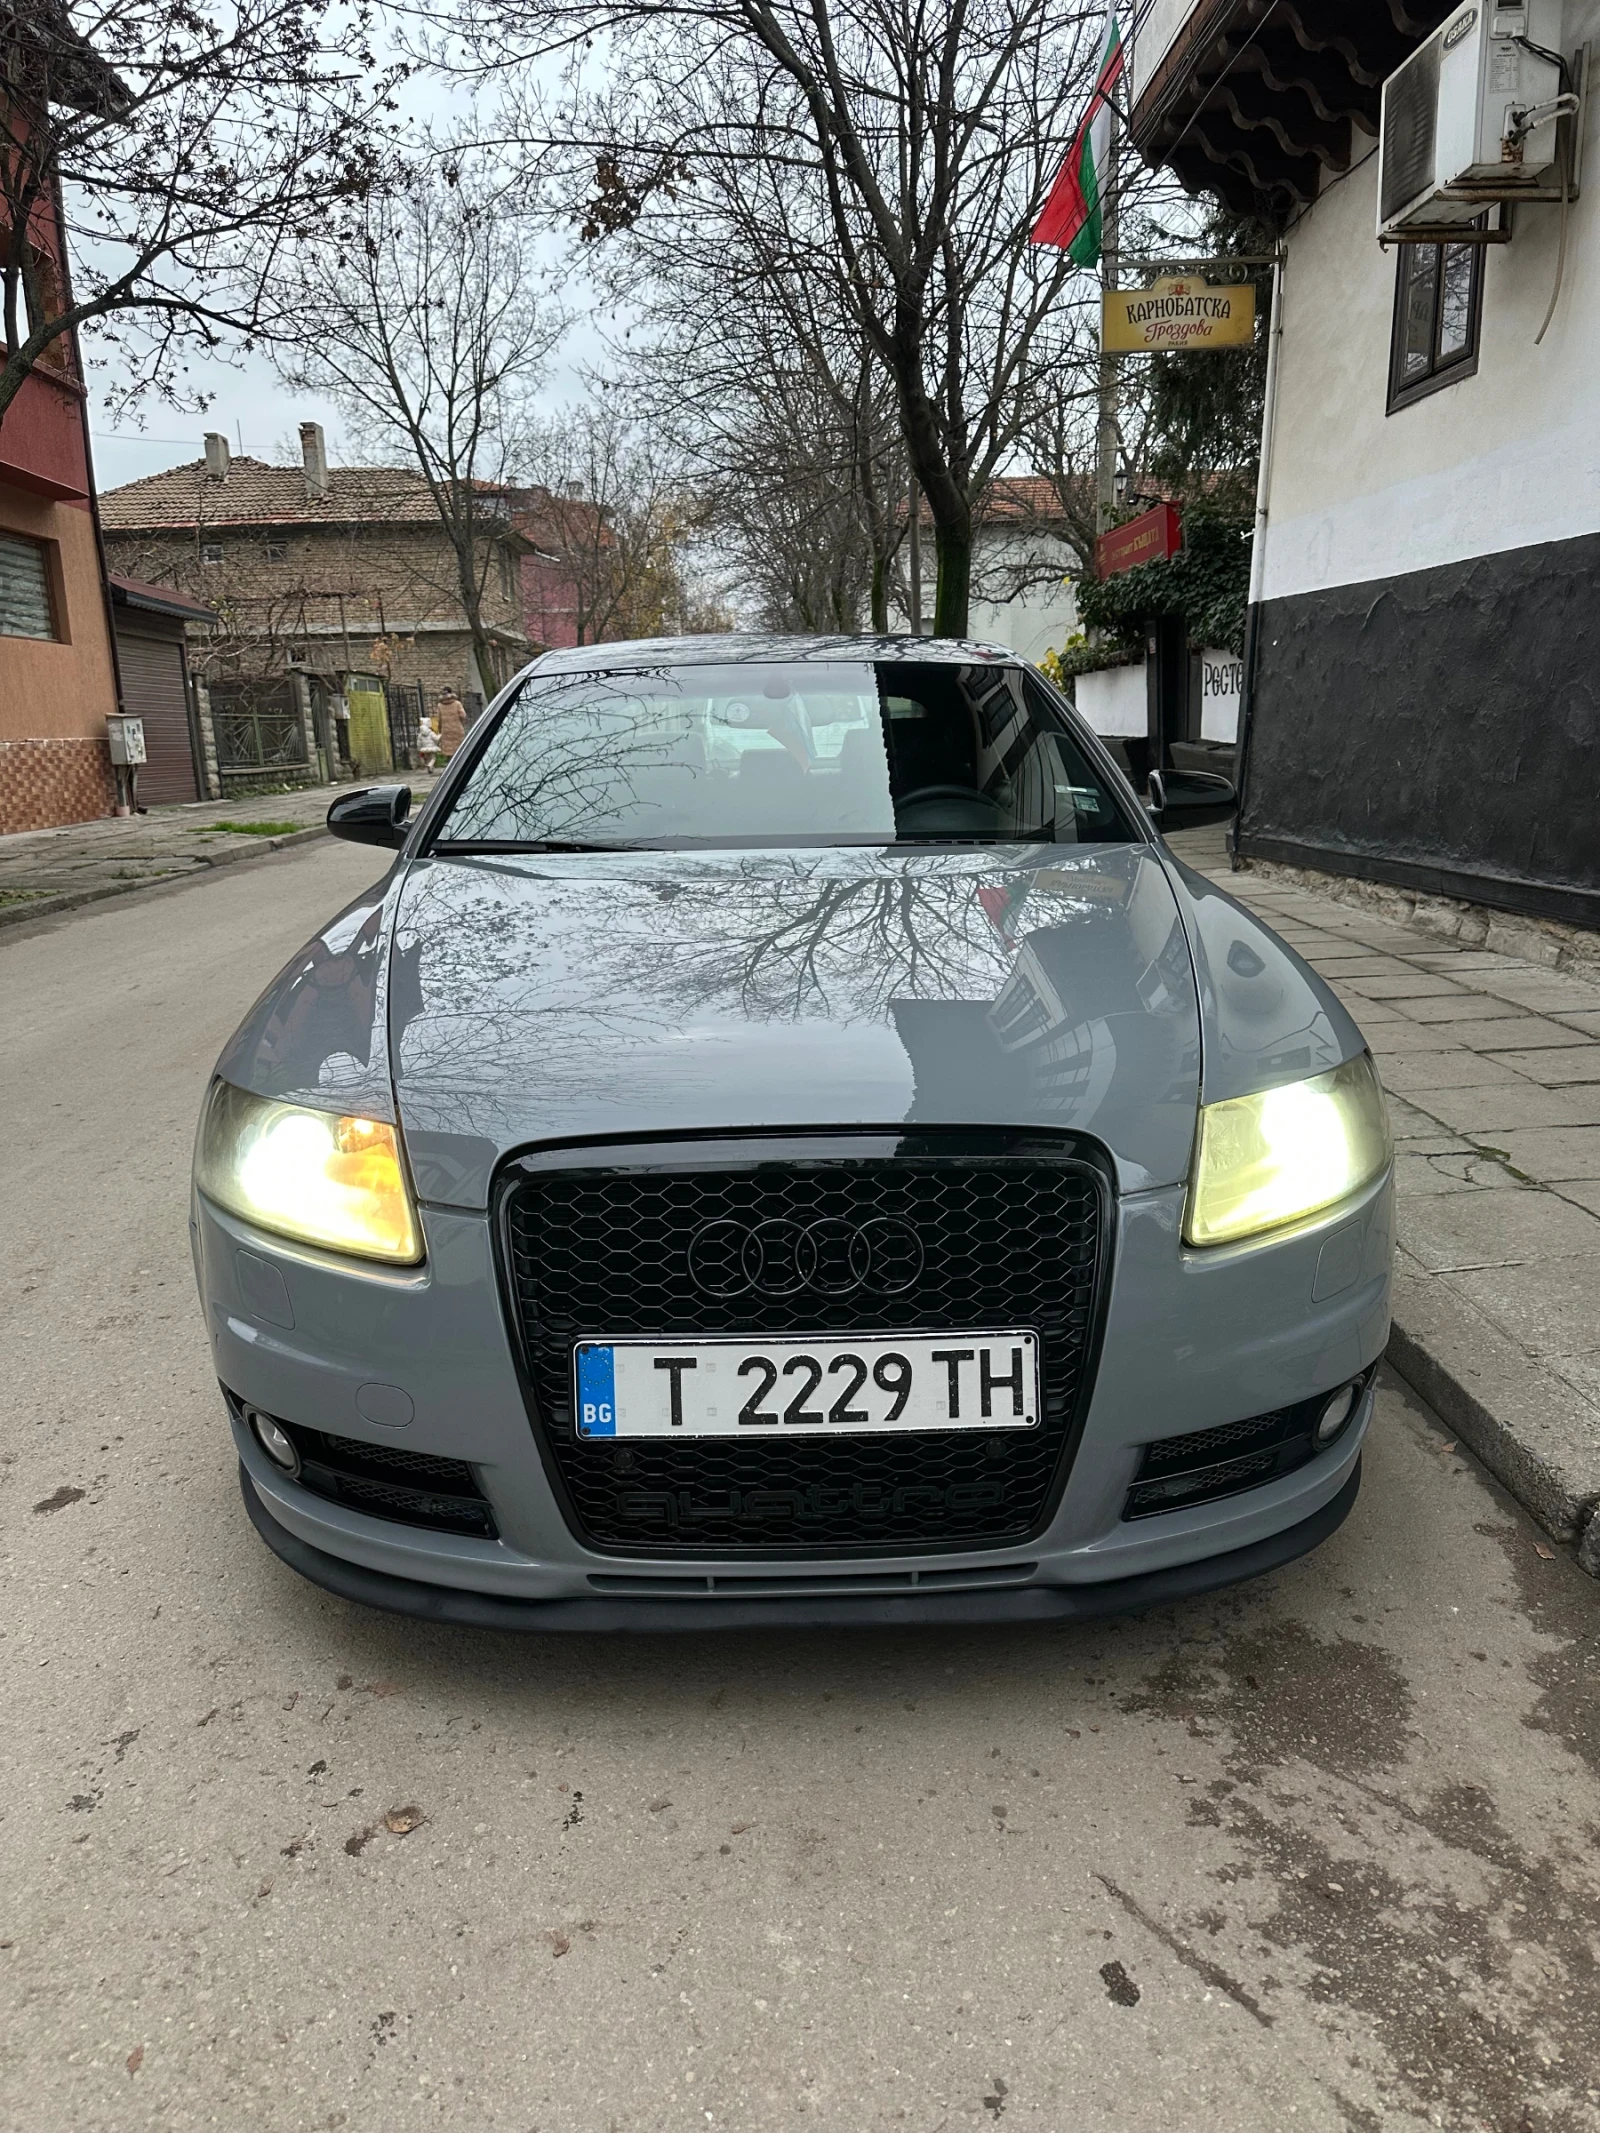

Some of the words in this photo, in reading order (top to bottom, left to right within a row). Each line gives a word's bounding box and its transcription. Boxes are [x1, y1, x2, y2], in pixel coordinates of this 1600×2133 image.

[1126, 297, 1231, 324] КАРНОБАТСКА
[1144, 319, 1214, 343] Гроздова
[653, 1357, 697, 1426] T
[737, 1352, 913, 1425] 2229
[931, 1347, 1024, 1418] TH
[583, 1403, 613, 1424] BG
[616, 1482, 1004, 1527] quattro
